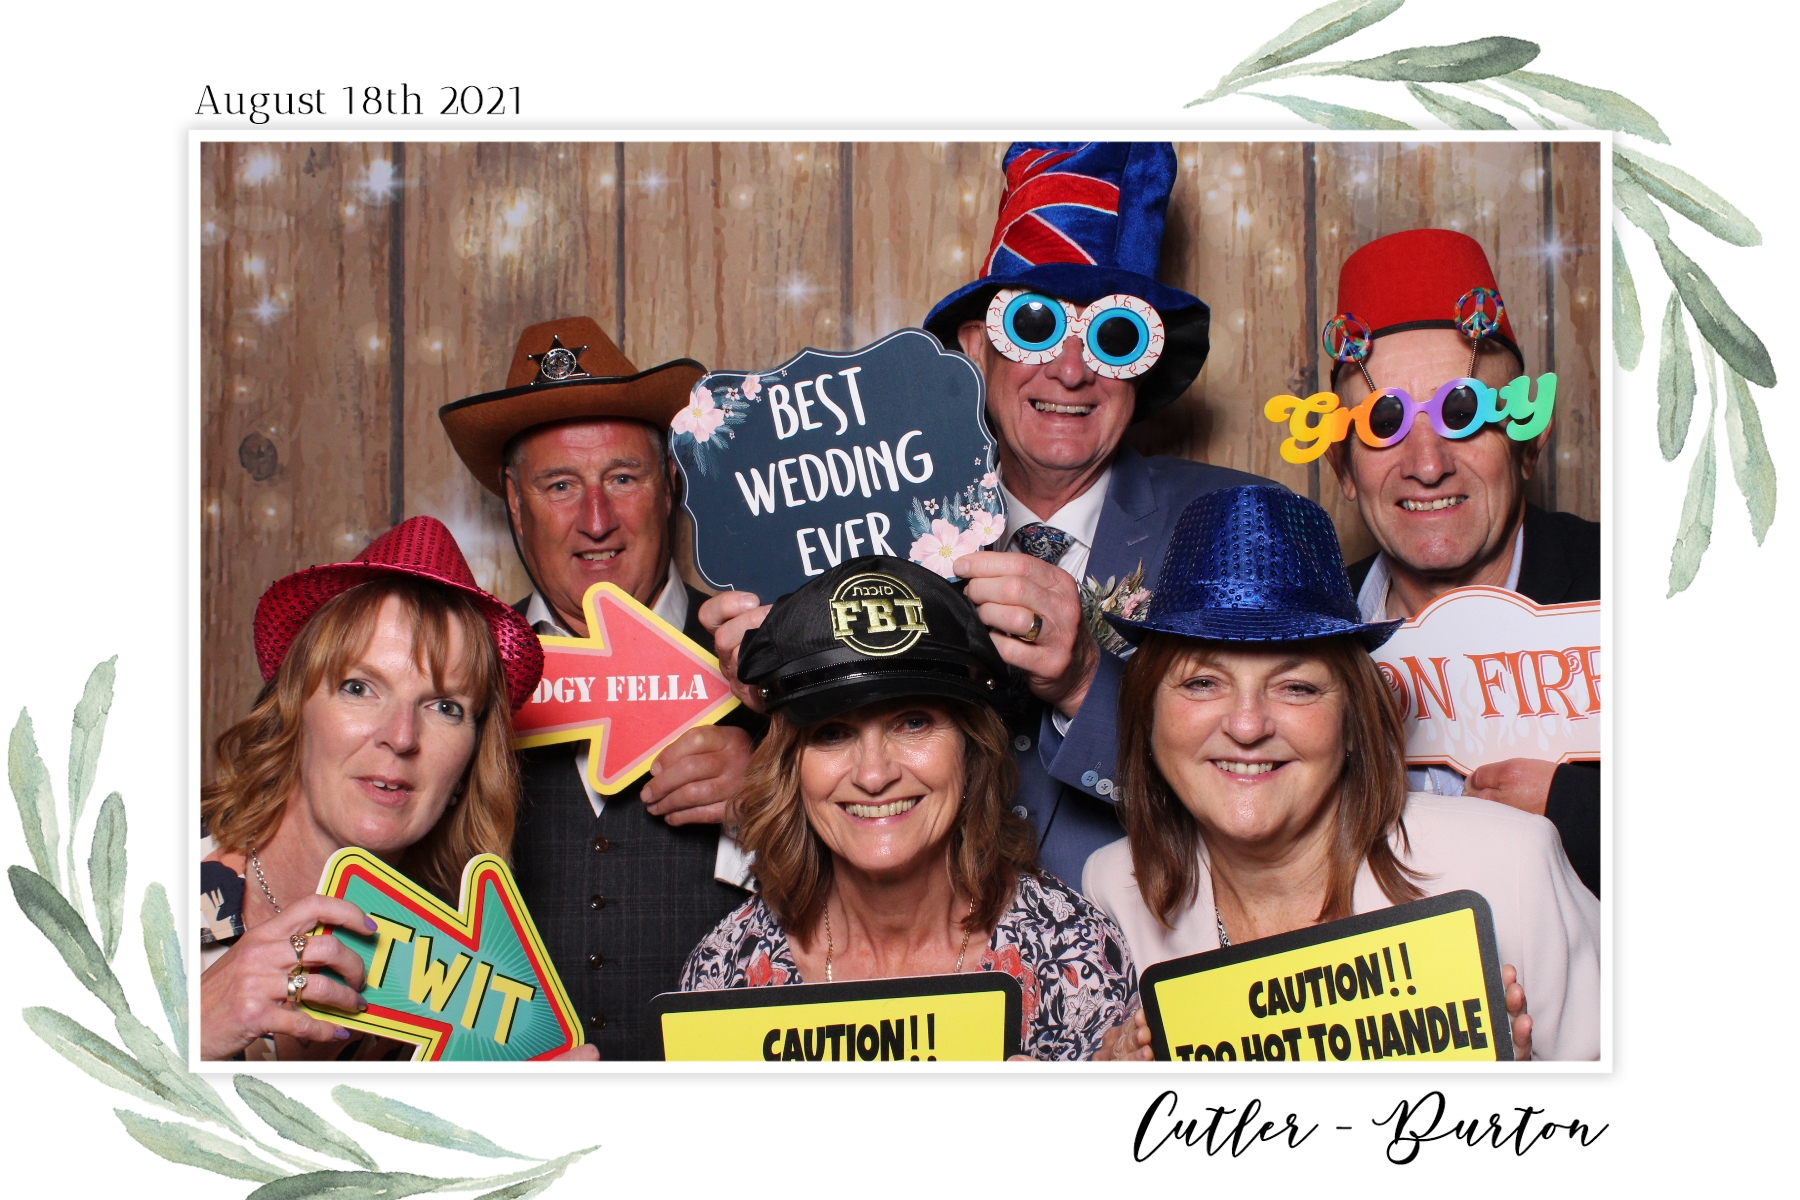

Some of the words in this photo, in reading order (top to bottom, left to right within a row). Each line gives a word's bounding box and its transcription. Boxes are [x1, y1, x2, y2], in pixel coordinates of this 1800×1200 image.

[768, 366, 867, 440] BEST
[734, 430, 934, 517] WEDDING
[796, 511, 898, 577] EVER
[831, 598, 927, 636] FBI
[606, 674, 709, 702] FELLA
[366, 912, 537, 1047] TWIT
[1248, 941, 1418, 1019] CAUTION!!
[762, 1012, 938, 1062] CAUTION!!
[1241, 1026, 1303, 1062] HOT
[1306, 1023, 1352, 1062] TO
[1355, 998, 1489, 1061] HANDLE
